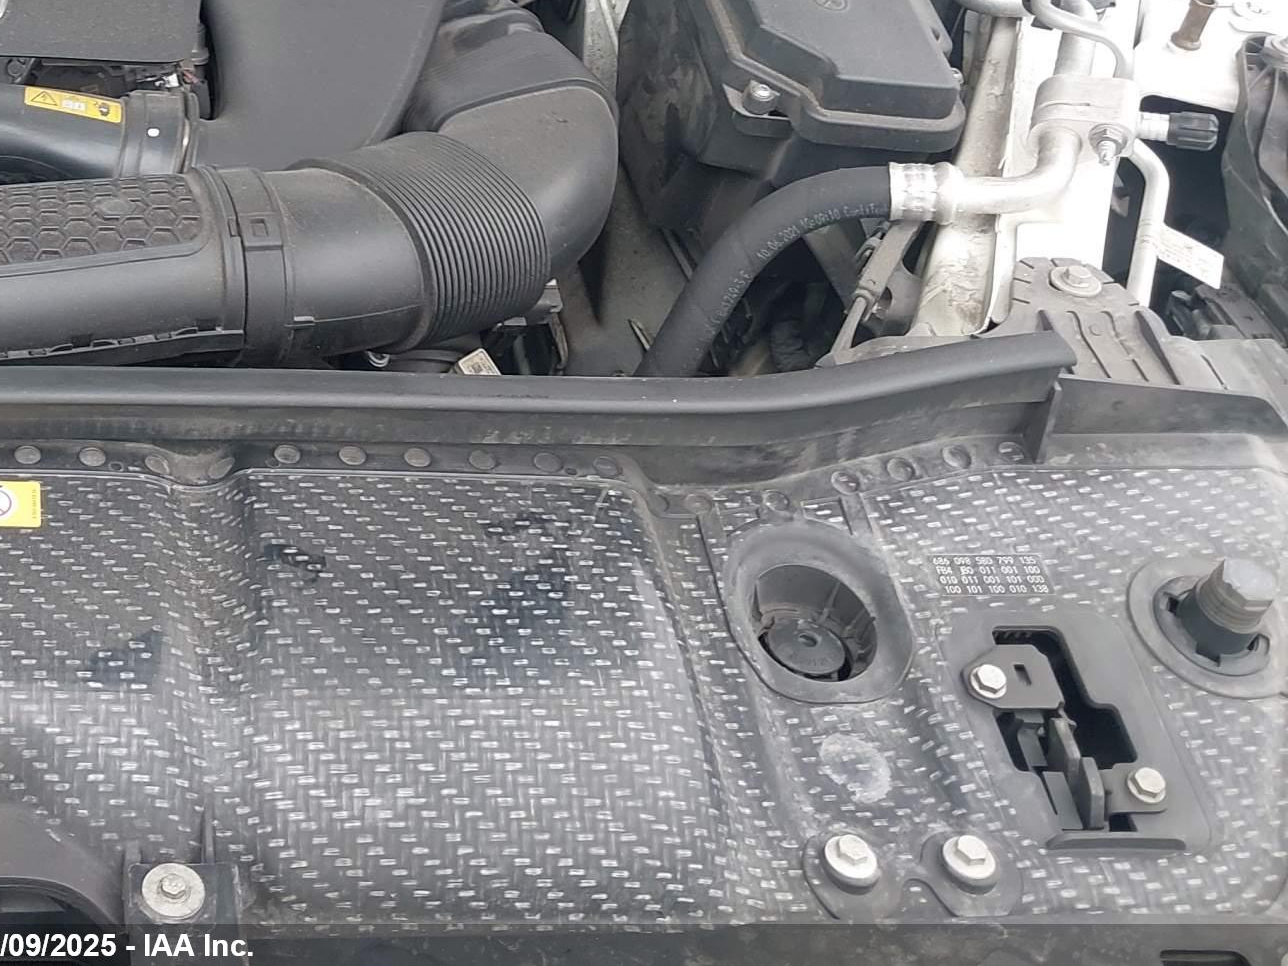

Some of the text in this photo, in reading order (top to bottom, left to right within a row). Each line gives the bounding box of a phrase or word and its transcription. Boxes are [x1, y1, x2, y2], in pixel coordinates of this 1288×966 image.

[932, 556, 950, 565] 686
[996, 556, 1014, 565] 799
[1019, 556, 1037, 565] 135
[935, 566, 953, 575] FB4
[978, 566, 996, 575] 011
[1000, 566, 1018, 575] 001
[1024, 566, 1040, 575] 100
[939, 575, 958, 584] 010
[961, 575, 978, 584] 011
[983, 575, 1001, 584] 001
[1006, 575, 1022, 584] 101
[944, 585, 962, 594] 100
[966, 585, 983, 594] 101
[988, 585, 1005, 594] 100
[1009, 585, 1027, 594] 010
